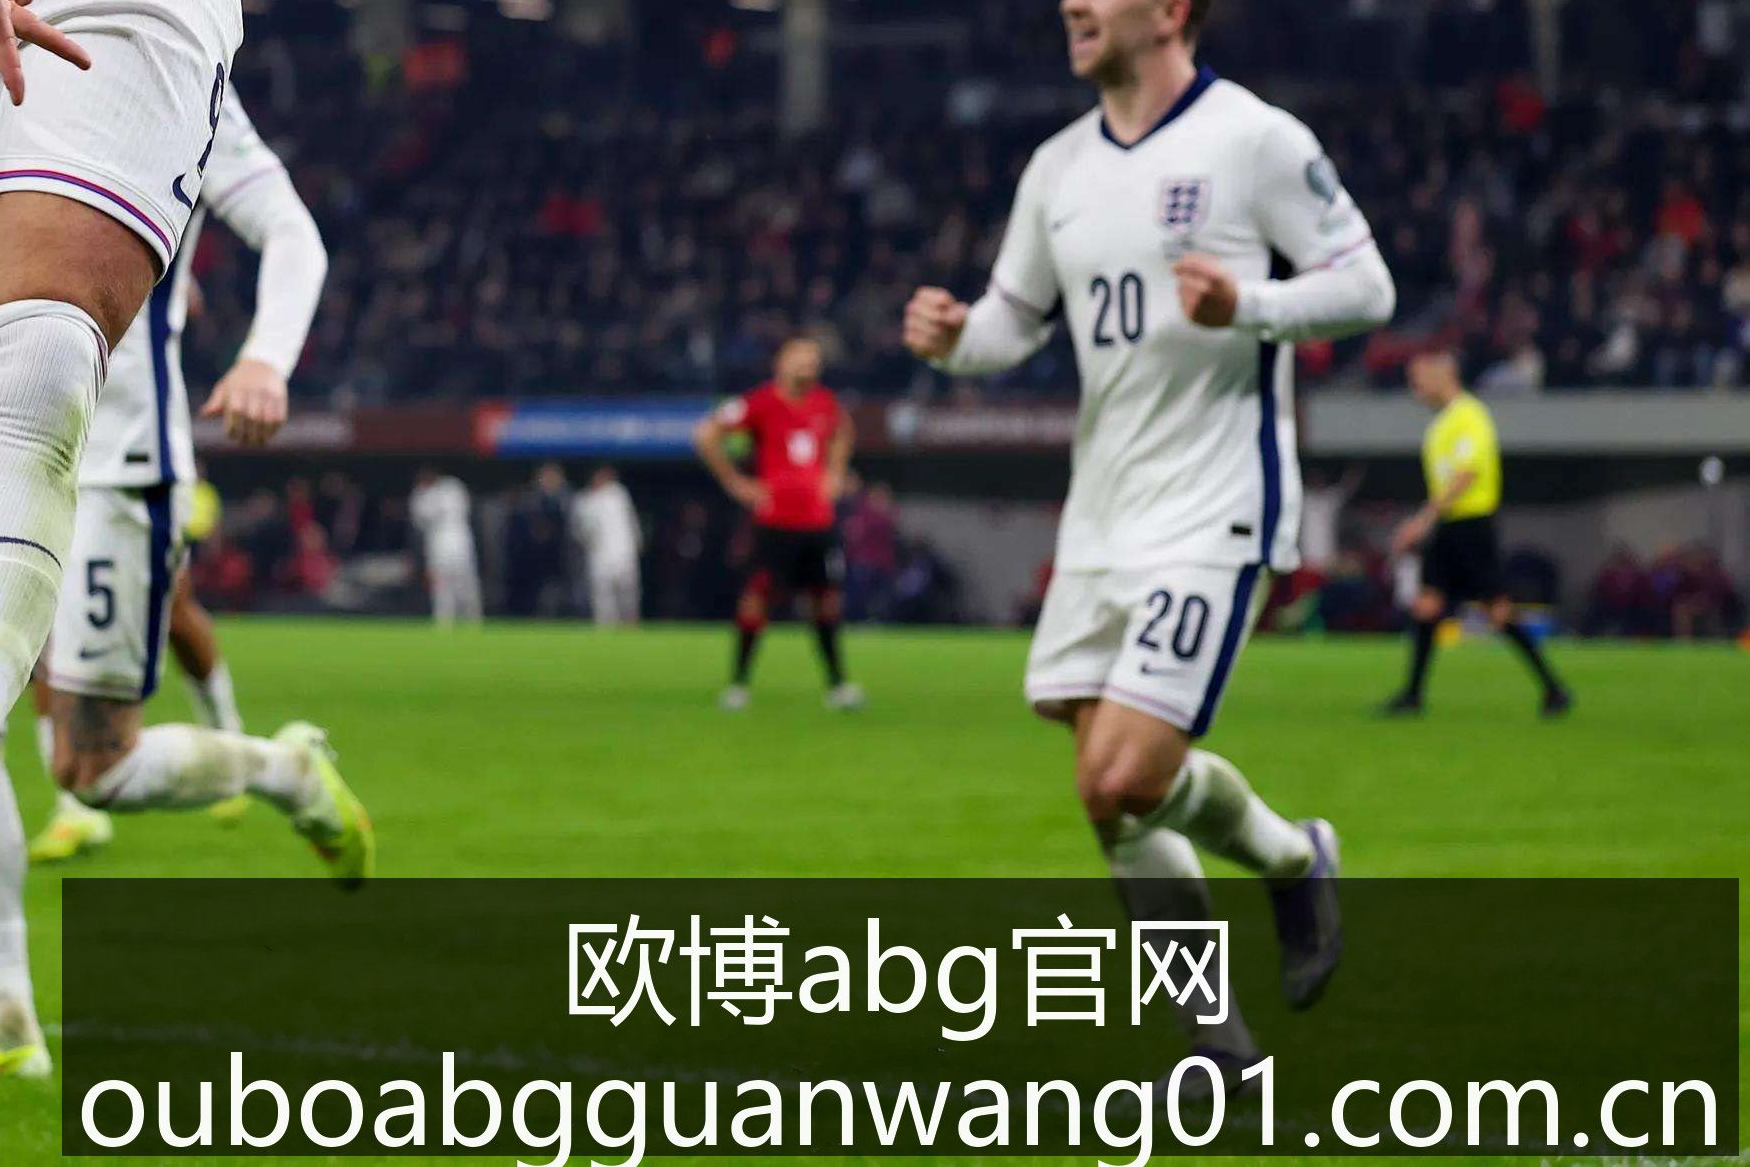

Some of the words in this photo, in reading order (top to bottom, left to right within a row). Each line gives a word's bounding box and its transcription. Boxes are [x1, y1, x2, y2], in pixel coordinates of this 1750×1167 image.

[1090, 272, 1144, 346] 20
[86, 558, 116, 630] 5
[1138, 589, 1210, 661] 20
